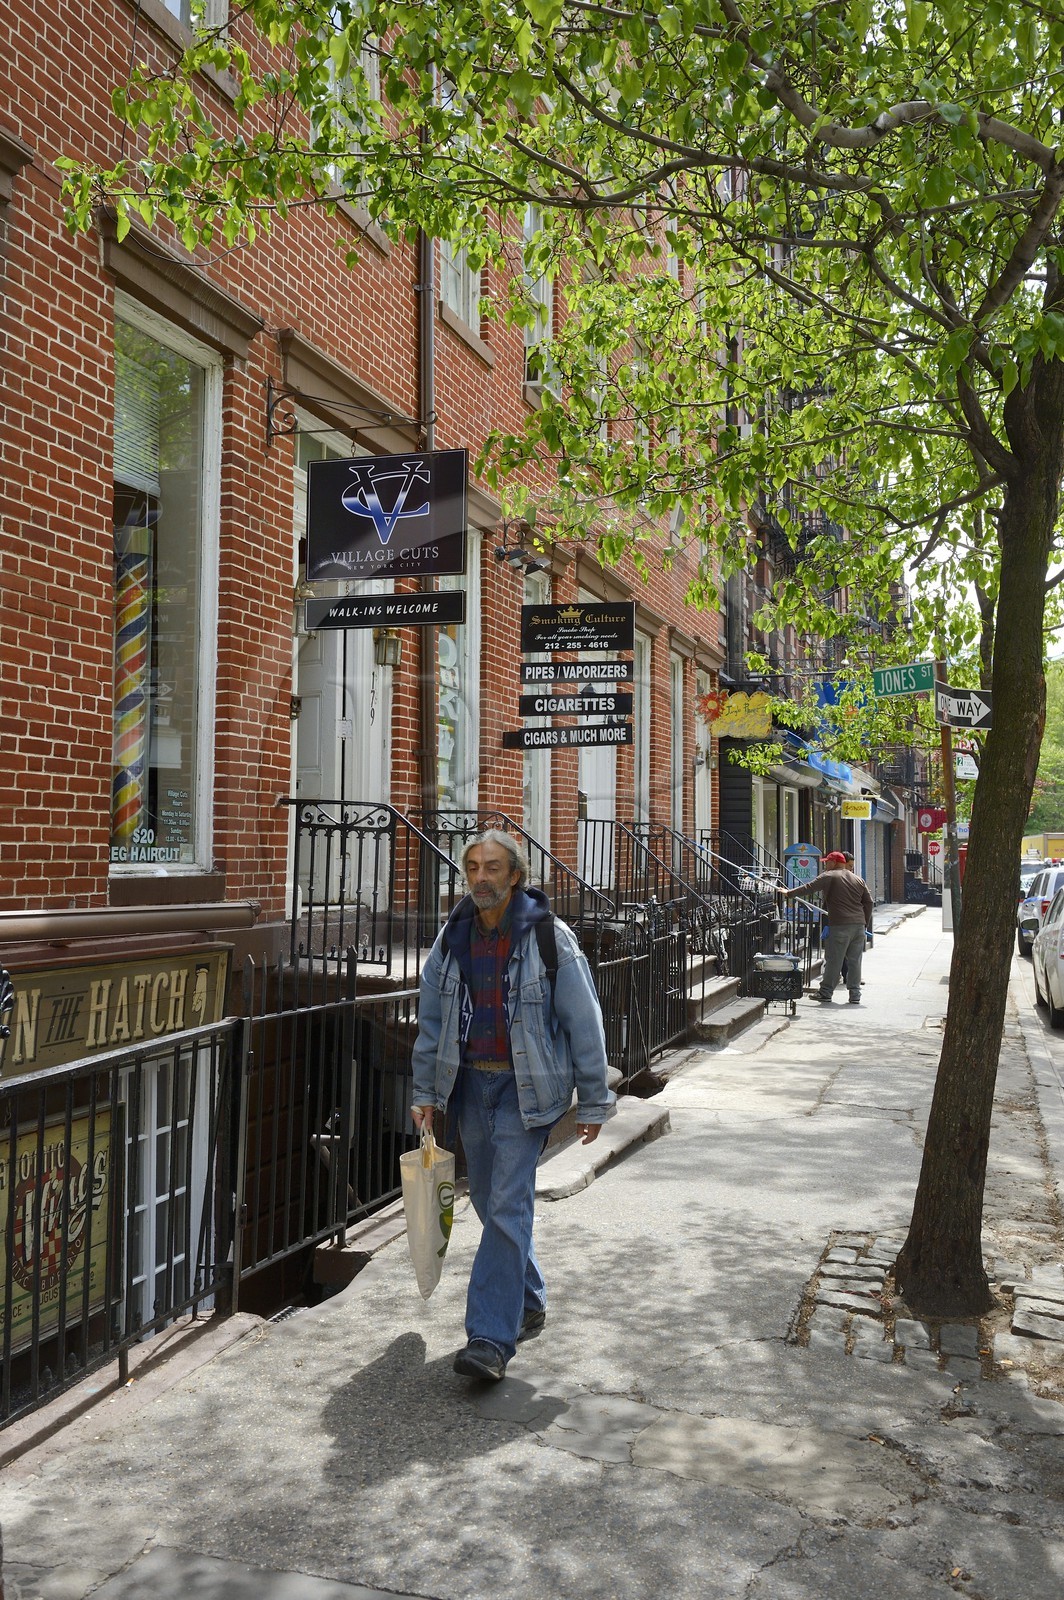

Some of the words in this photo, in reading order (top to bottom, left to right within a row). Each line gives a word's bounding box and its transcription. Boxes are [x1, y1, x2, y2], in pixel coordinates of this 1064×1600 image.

[330, 549, 395, 564] VILLAGE
[400, 546, 439, 560] CUTS
[328, 606, 382, 618] WALK-INS
[386, 602, 439, 615] WELCOME
[528, 615, 581, 626] Smoking
[584, 614, 626, 624] Culture
[578, 626, 596, 634] Shop
[544, 642, 560, 650] 212
[526, 666, 555, 680] PIPES
[557, 666, 560, 679] /
[562, 664, 628, 678] VAPORIZERS
[878, 668, 916, 694] JONES
[921, 666, 932, 678] ST
[534, 698, 616, 712] CIGARETTES
[956, 701, 982, 716] WAY
[524, 732, 558, 746] CIGARS
[560, 731, 568, 743] &
[570, 730, 598, 744] MUCH
[600, 728, 626, 742] MORE
[133, 828, 154, 844] $20
[109, 846, 127, 862] EG
[131, 846, 180, 862] HAIRCUT
[45, 996, 85, 1043] THE
[86, 969, 189, 1047] HATCH
